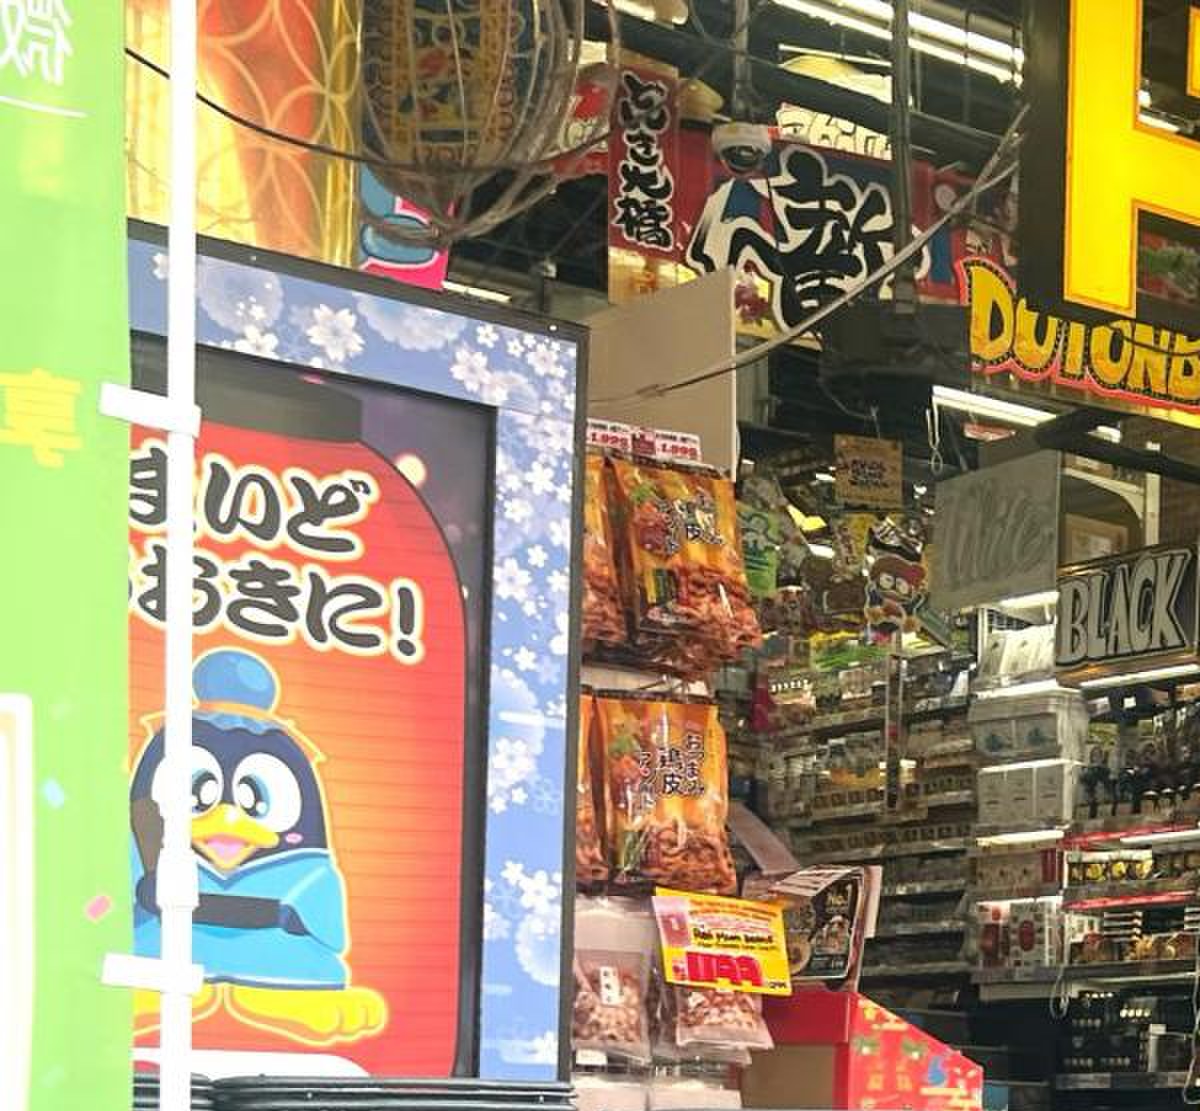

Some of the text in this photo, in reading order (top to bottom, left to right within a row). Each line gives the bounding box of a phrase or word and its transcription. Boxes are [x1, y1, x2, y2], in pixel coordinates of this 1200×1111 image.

[129, 544, 417, 656] おきに!
[1056, 547, 1193, 664] BLACK
